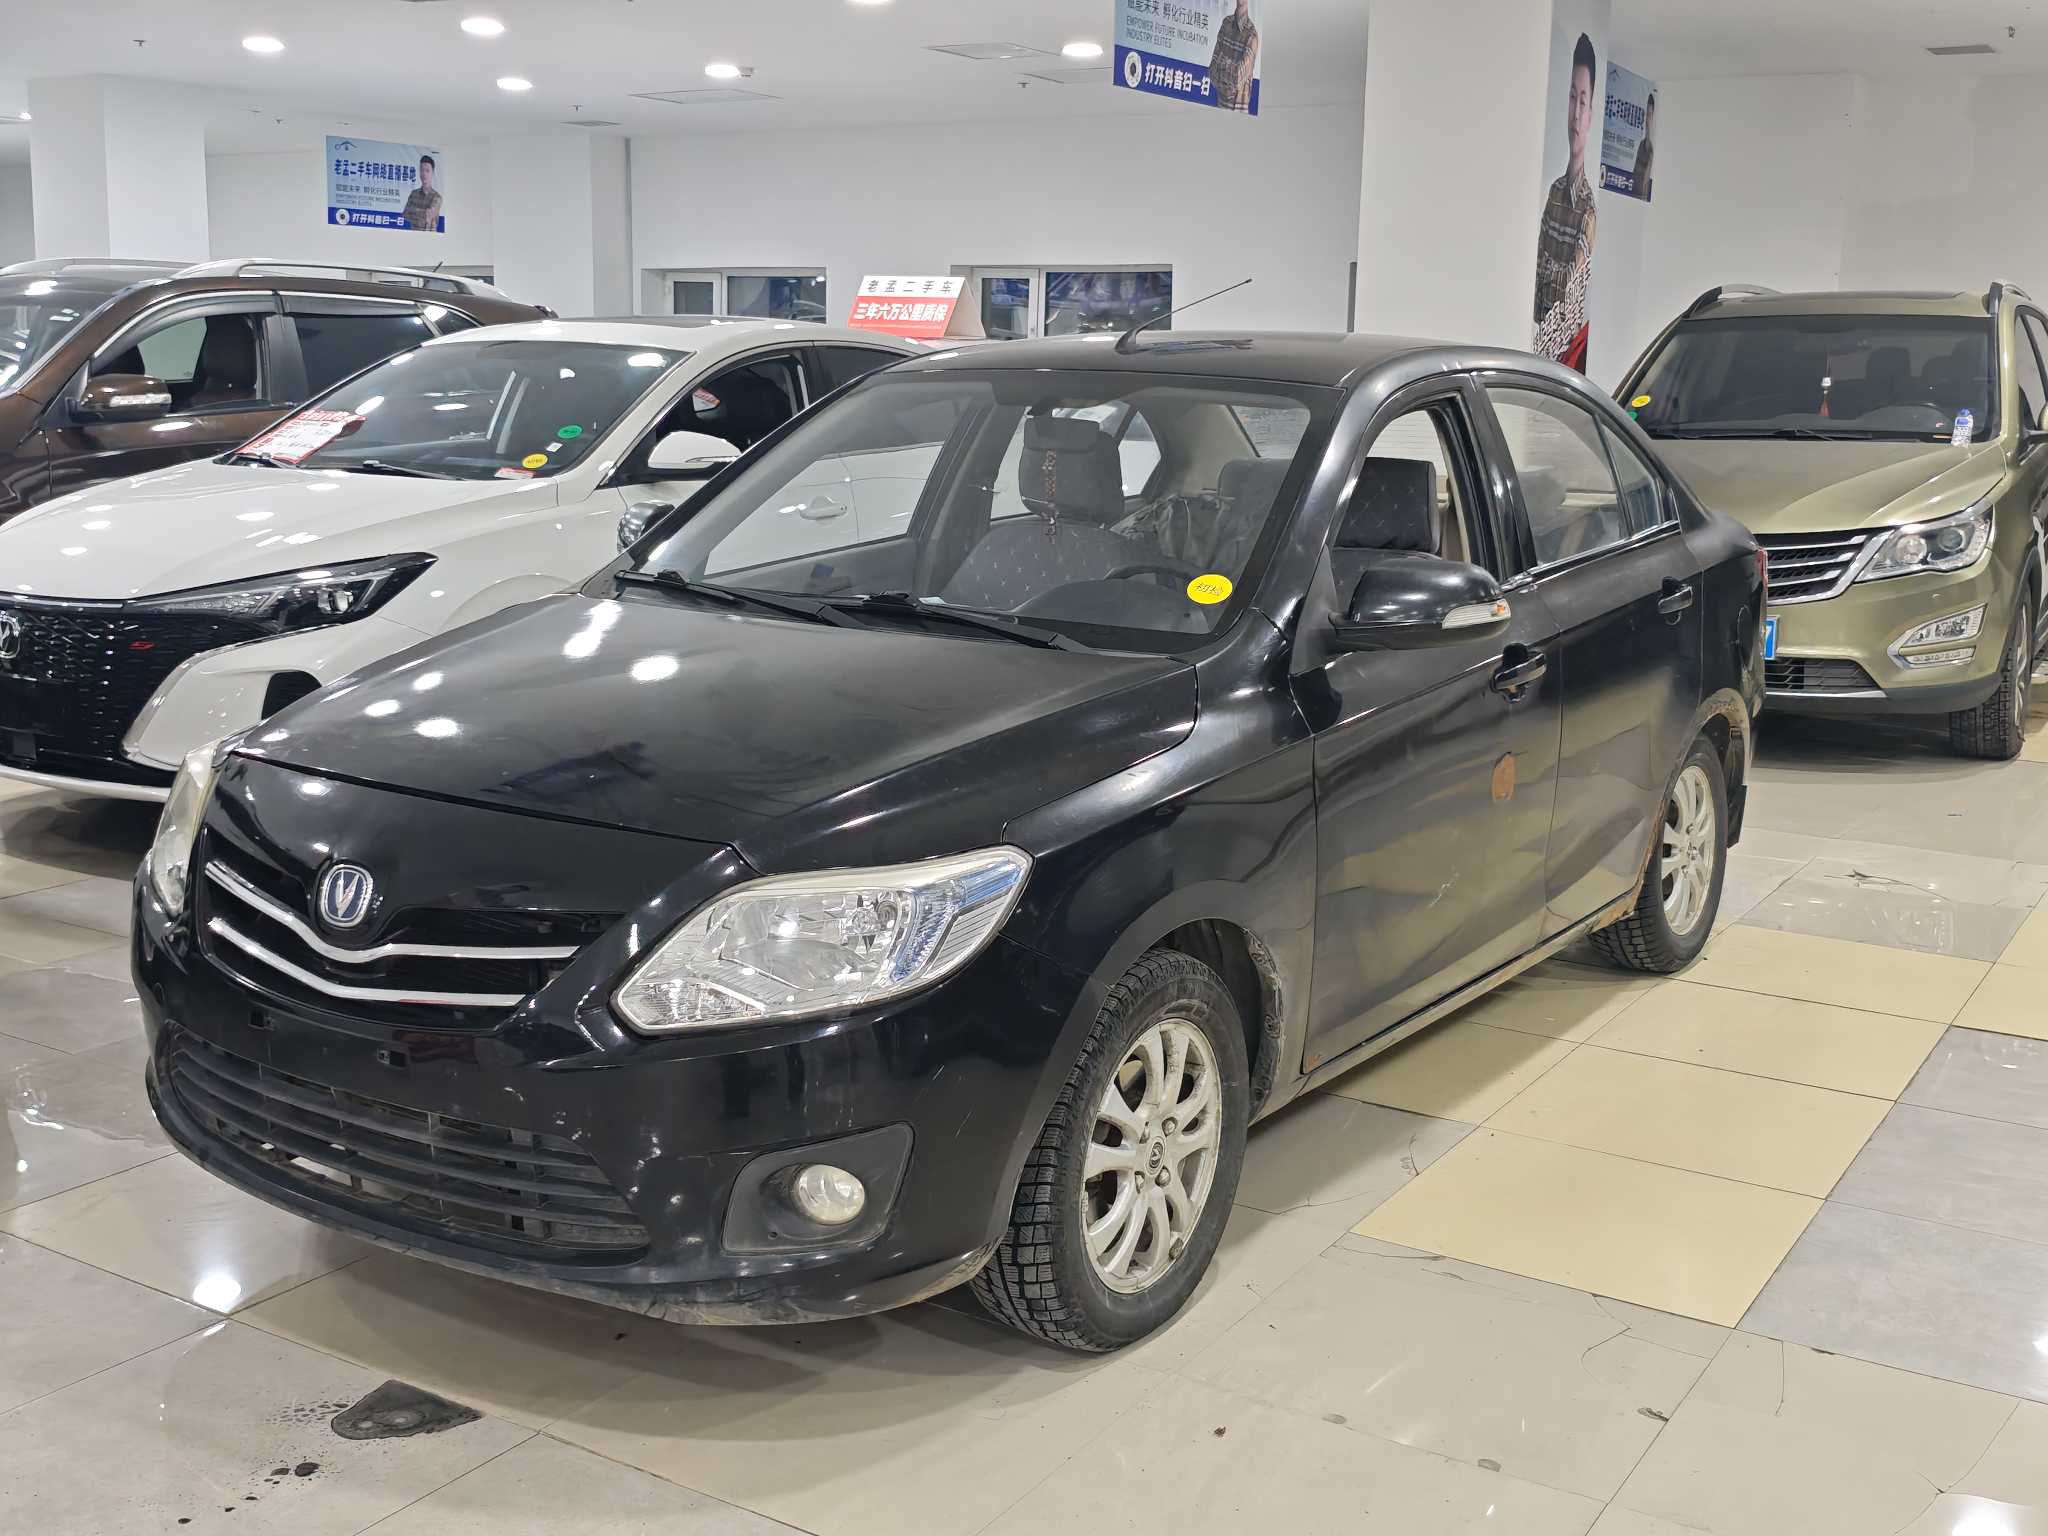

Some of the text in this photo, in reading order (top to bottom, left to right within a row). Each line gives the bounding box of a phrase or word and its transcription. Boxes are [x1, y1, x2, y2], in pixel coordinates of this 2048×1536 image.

[1126, 15, 1209, 47] EMPOWER FUTURE INCUBATION
[1126, 27, 1172, 49] INDUSTRY ELITES
[1144, 62, 1210, 96] 打开抖音扫一扫
[867, 280, 954, 294] 老孟二手车
[853, 302, 948, 321] 三年六万公里质保
